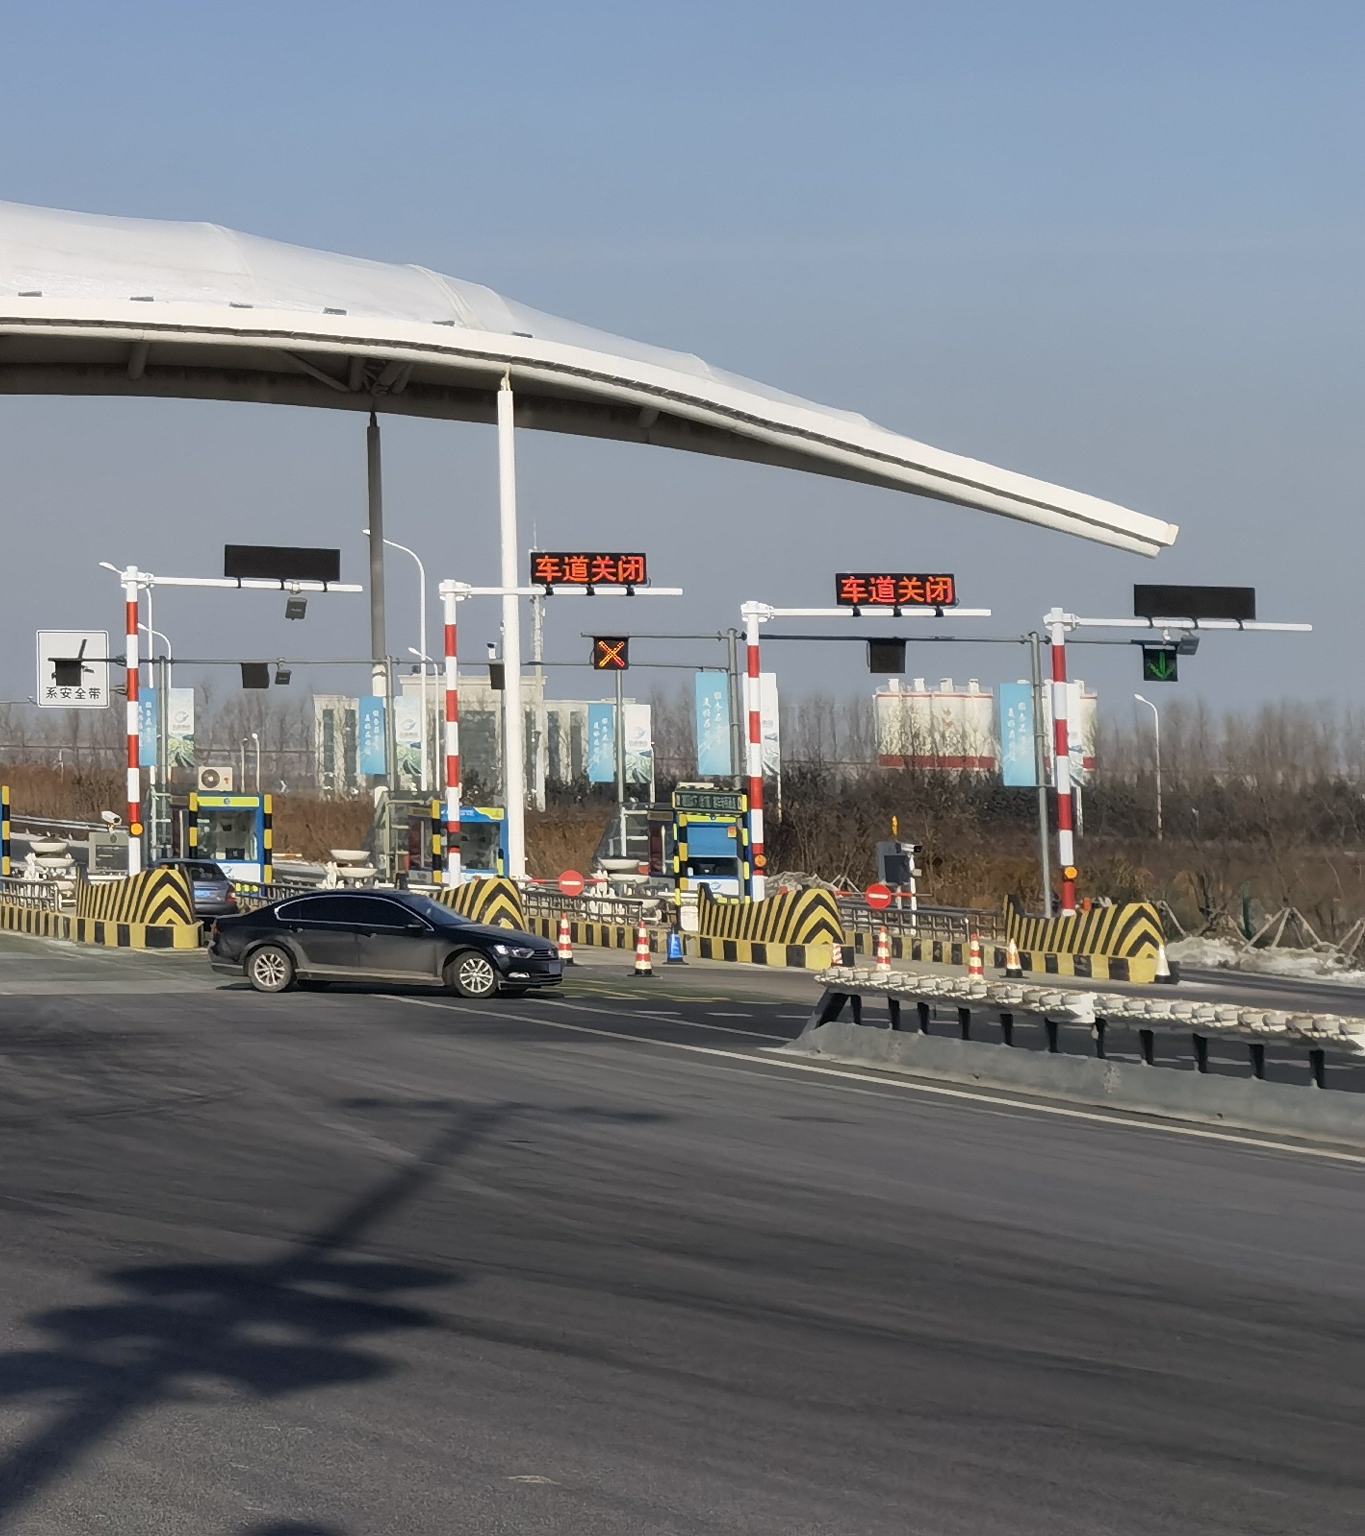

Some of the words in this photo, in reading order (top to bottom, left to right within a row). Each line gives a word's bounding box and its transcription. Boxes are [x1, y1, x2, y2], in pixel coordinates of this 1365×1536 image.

[535, 554, 644, 583] 车道关闭
[841, 575, 953, 604] 车道关闭
[45, 686, 102, 700] 系安全带
